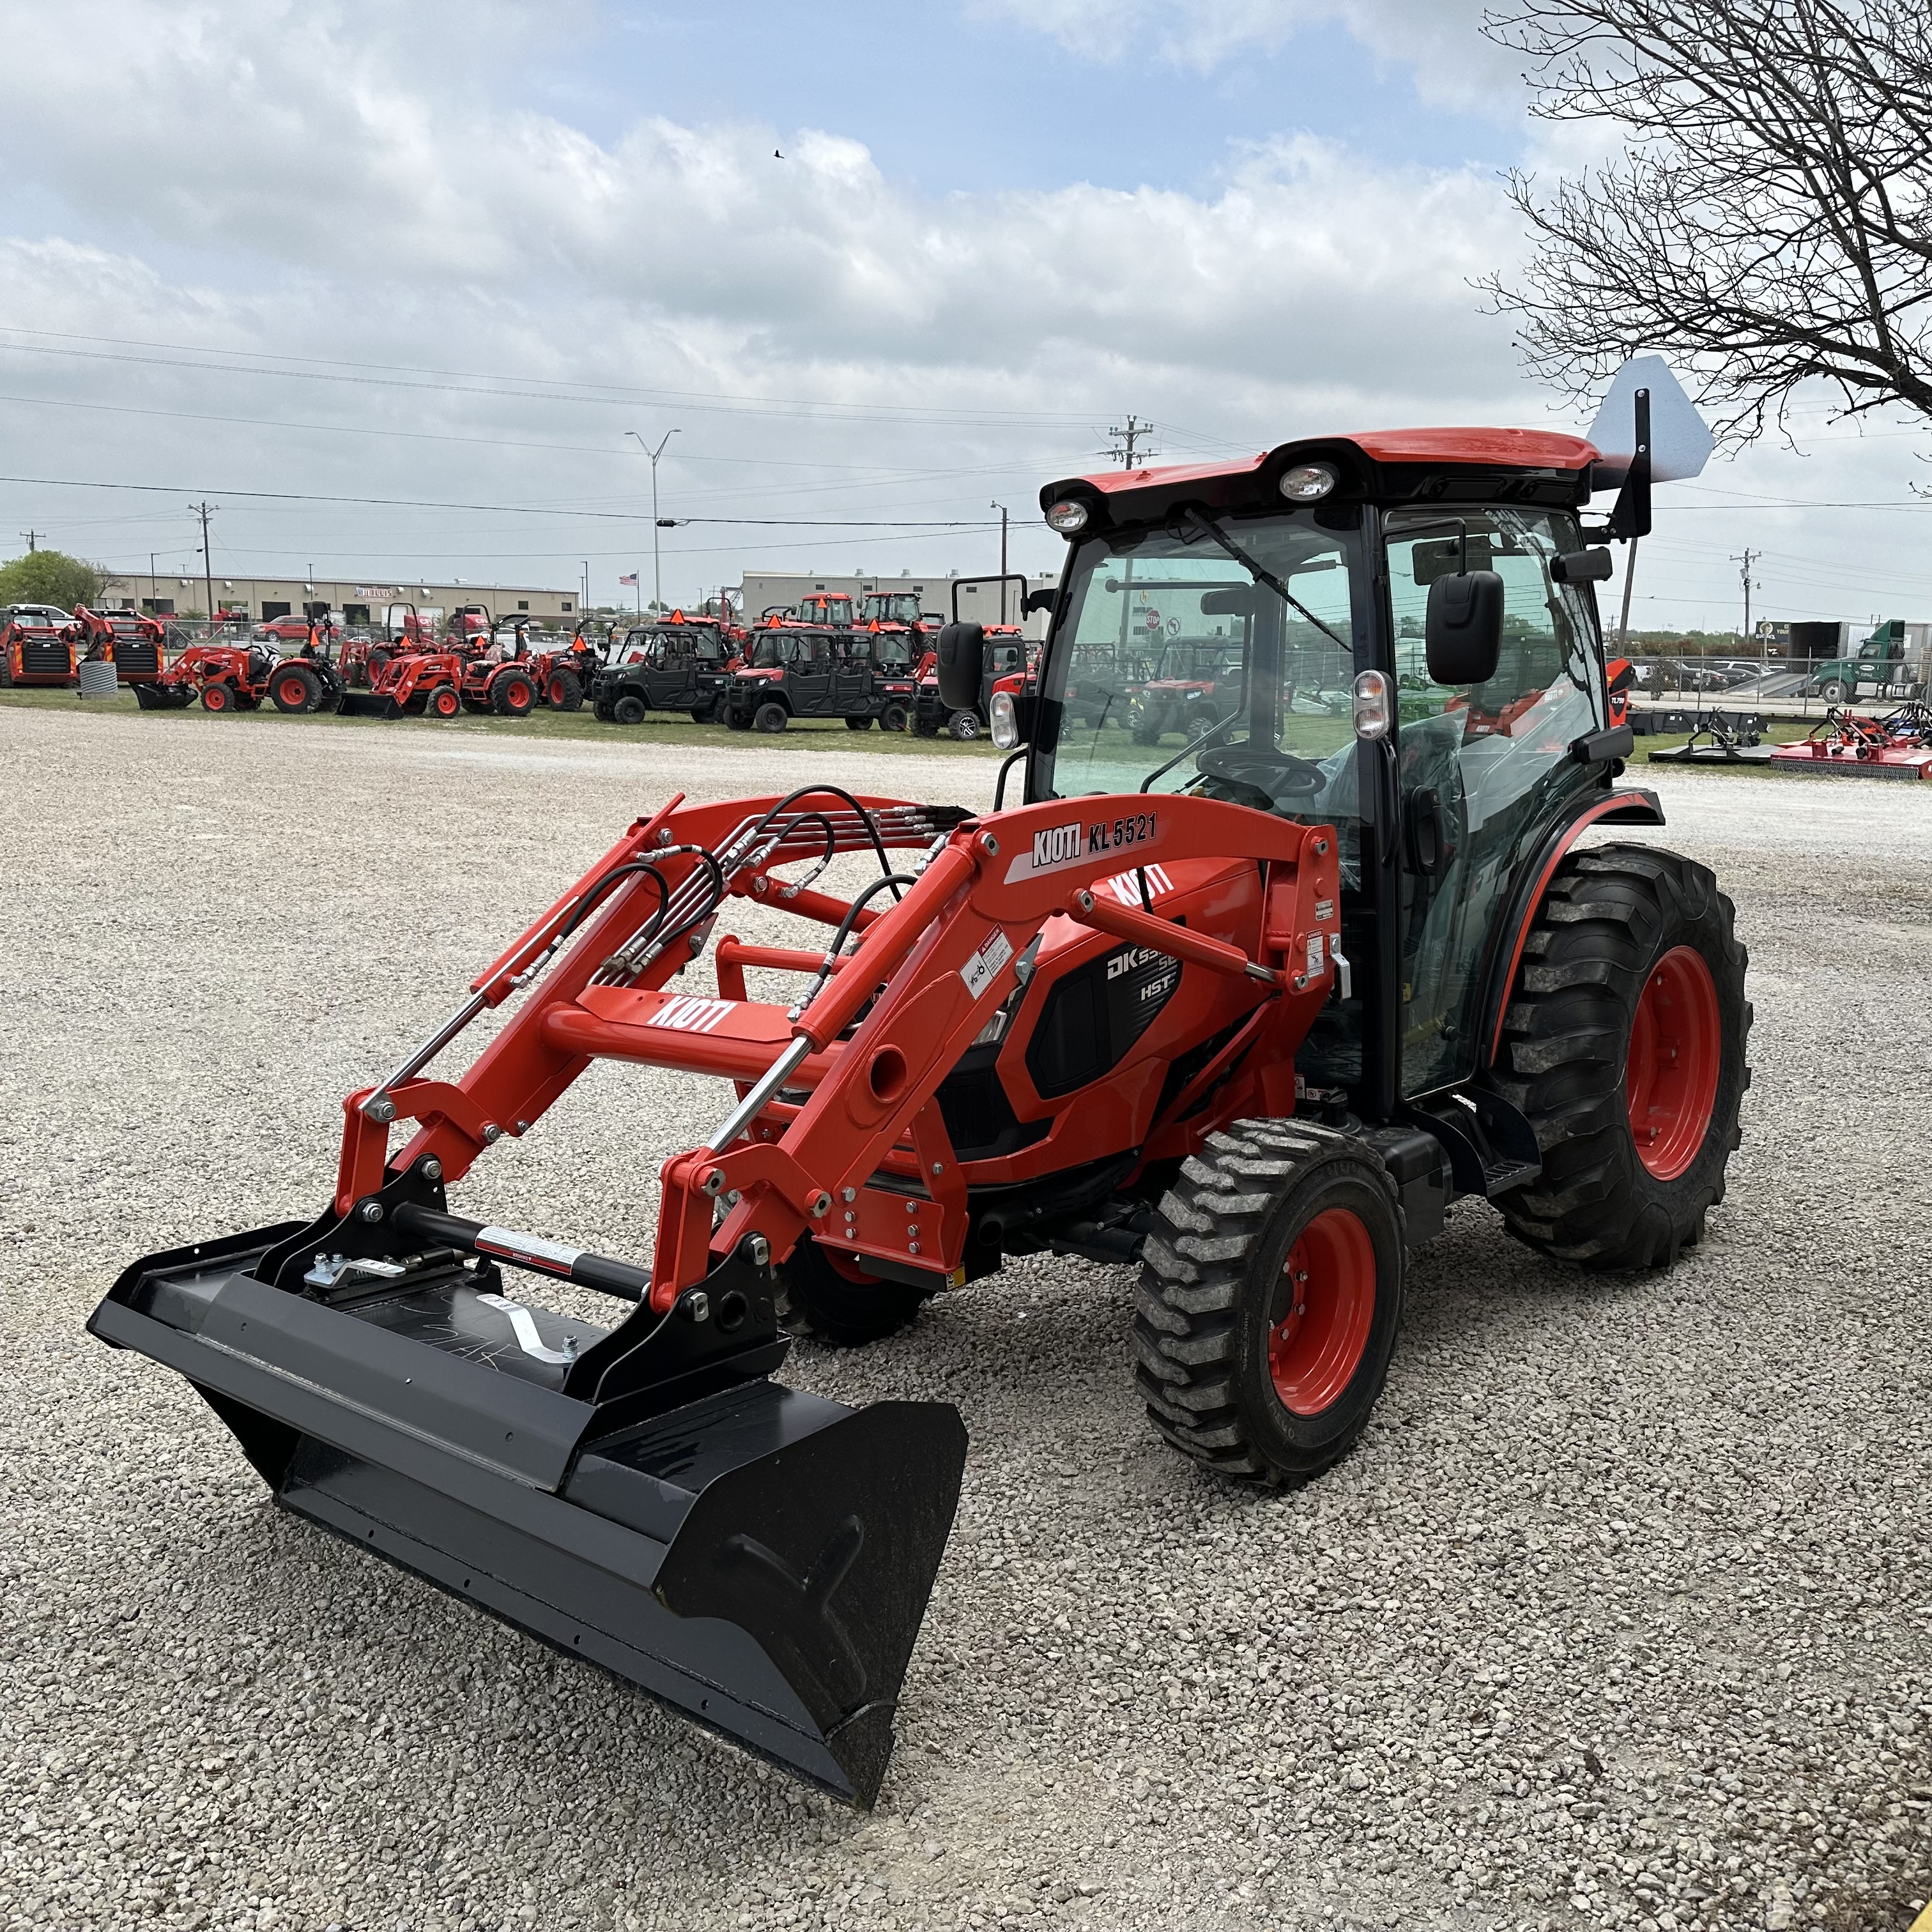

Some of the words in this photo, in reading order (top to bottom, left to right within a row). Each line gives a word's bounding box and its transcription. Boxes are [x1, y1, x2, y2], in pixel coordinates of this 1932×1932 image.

[1146, 615, 1160, 624] STOP
[1033, 822, 1081, 867] KIOTI
[1141, 974, 1171, 1001] HST
[646, 995, 739, 1032] KIOTI
